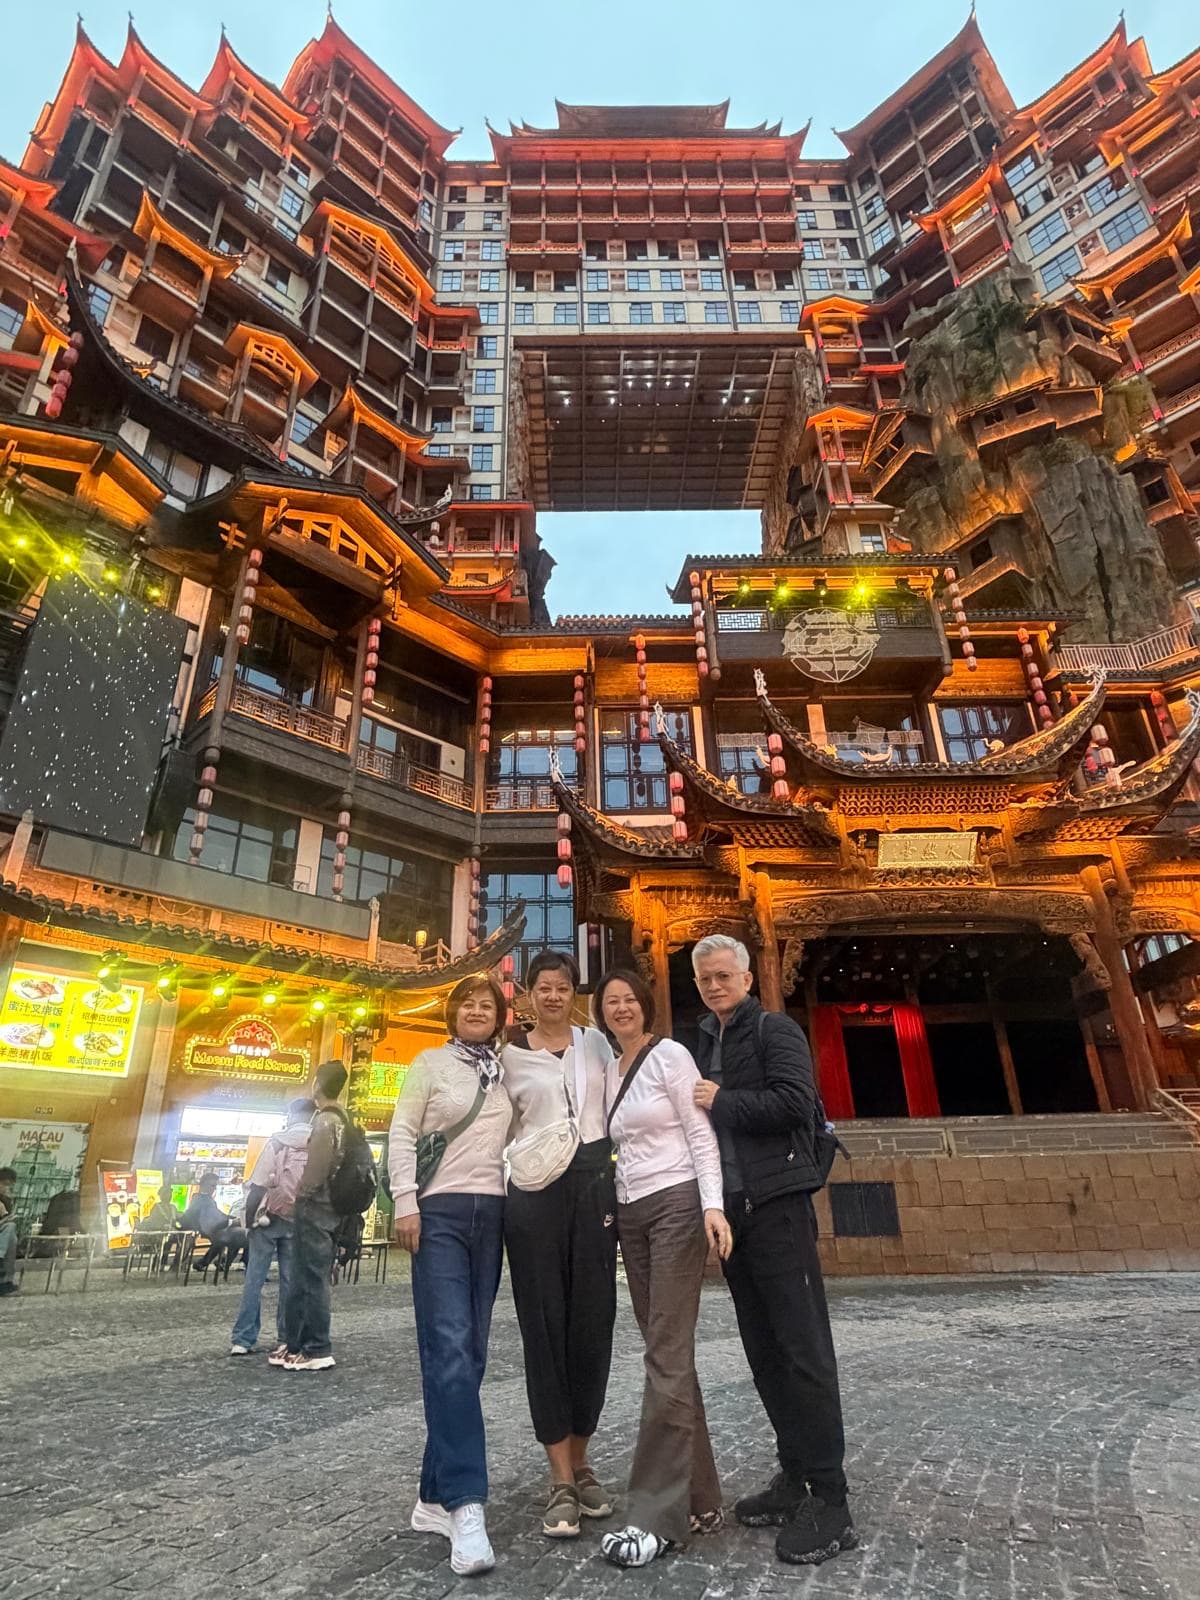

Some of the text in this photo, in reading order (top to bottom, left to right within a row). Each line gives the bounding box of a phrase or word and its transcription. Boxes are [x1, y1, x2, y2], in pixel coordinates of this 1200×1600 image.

[8, 1000, 63, 1016] 蜜汁叉烧饭
[193, 1051, 301, 1074] Macau Food Street
[20, 1130, 64, 1143] MACAU
